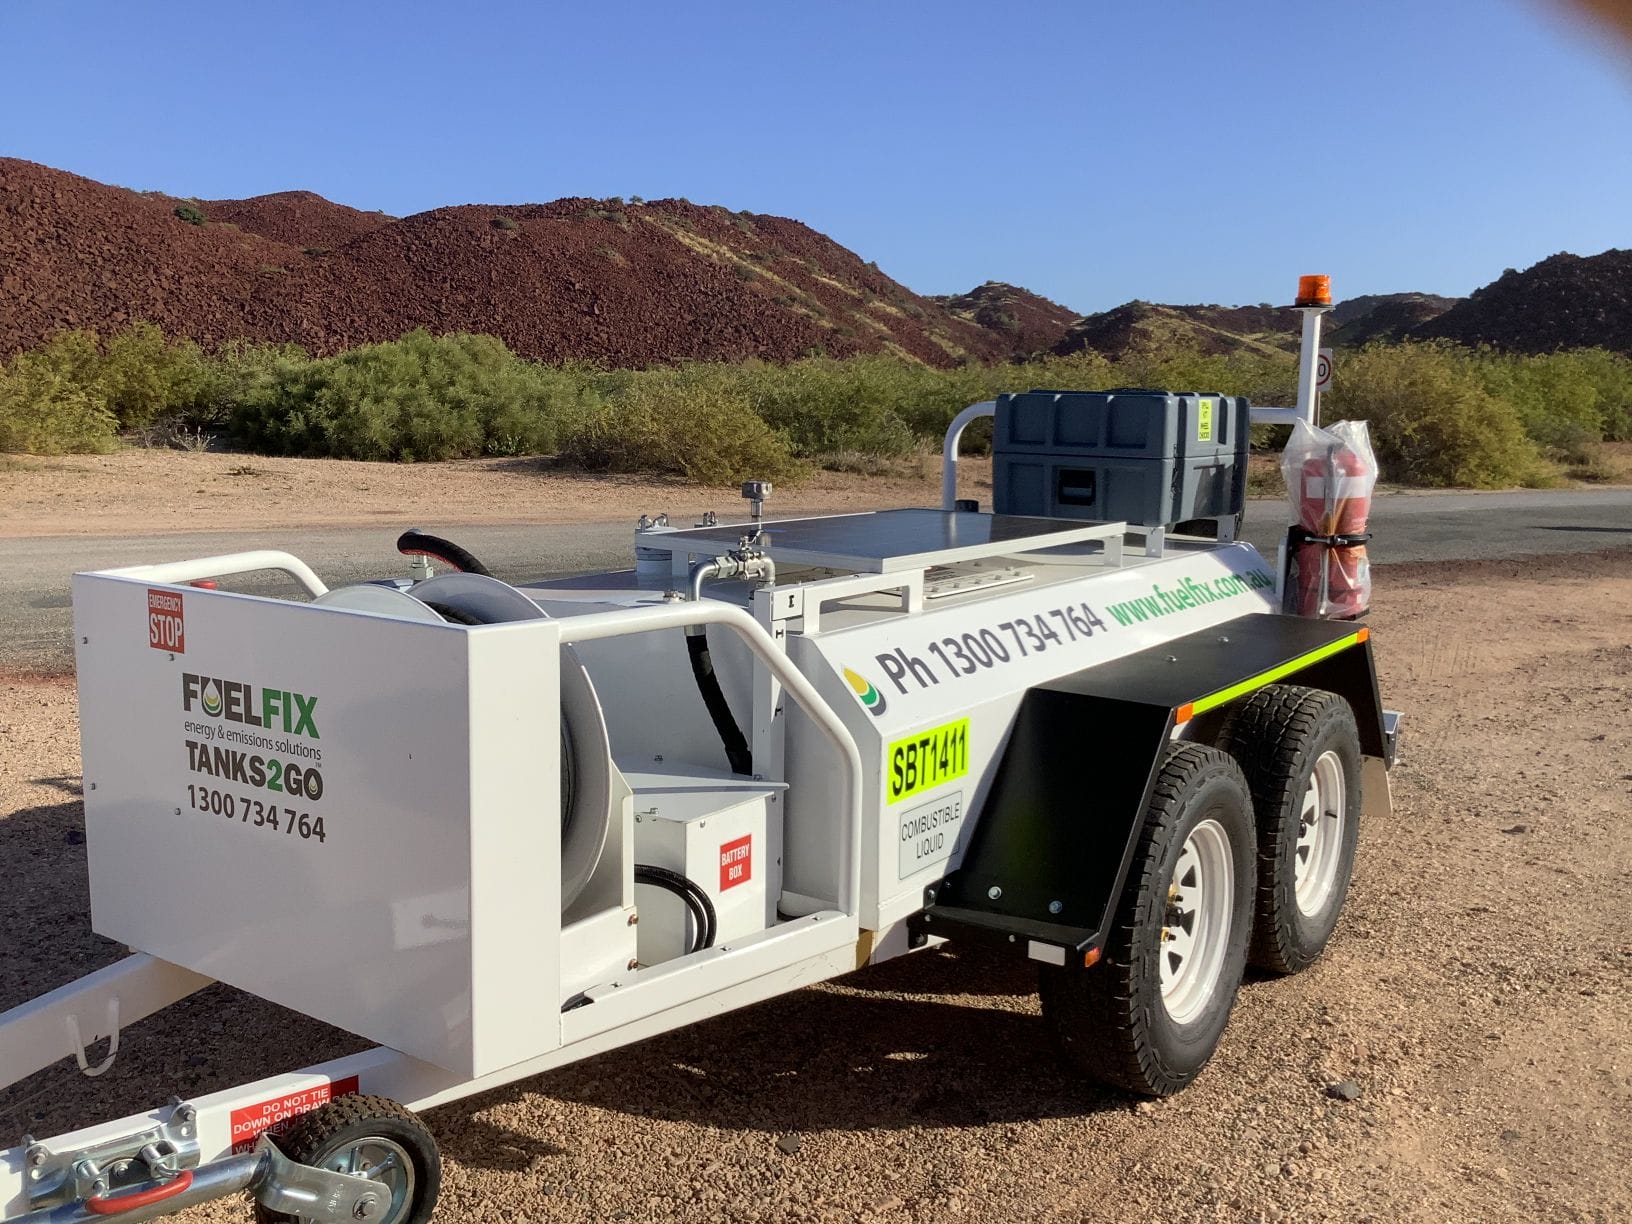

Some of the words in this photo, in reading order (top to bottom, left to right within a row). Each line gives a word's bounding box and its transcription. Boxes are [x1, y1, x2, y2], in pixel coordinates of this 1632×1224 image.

[149, 593, 182, 612] EMERGENCY
[150, 612, 183, 647] STOP
[875, 647, 939, 695] Ph
[928, 628, 1011, 678] 1300
[998, 613, 1063, 656] 734
[1048, 602, 1108, 642] 764
[1105, 568, 1272, 627] www.fuelfix.com.au
[182, 672, 321, 739] FUELFIX
[184, 720, 216, 740] energy
[217, 724, 225, 739] &
[226, 729, 273, 751] emissions
[275, 738, 322, 761] solutions
[185, 739, 324, 801] TANKS2GO
[892, 724, 965, 797] SBT1411
[187, 784, 235, 819] 1300
[239, 797, 280, 831] 734
[284, 808, 326, 844] 764
[901, 802, 961, 842] COMBUSTIBLE
[721, 842, 750, 867] BATTERY
[916, 832, 944, 859] LIQUID
[728, 863, 743, 881] BOX
[262, 1102, 280, 1115] DO
[283, 1094, 308, 1109] NOT
[310, 1087, 329, 1100] TIE
[233, 1115, 271, 1135] DOWN
[274, 1109, 292, 1122] ON
